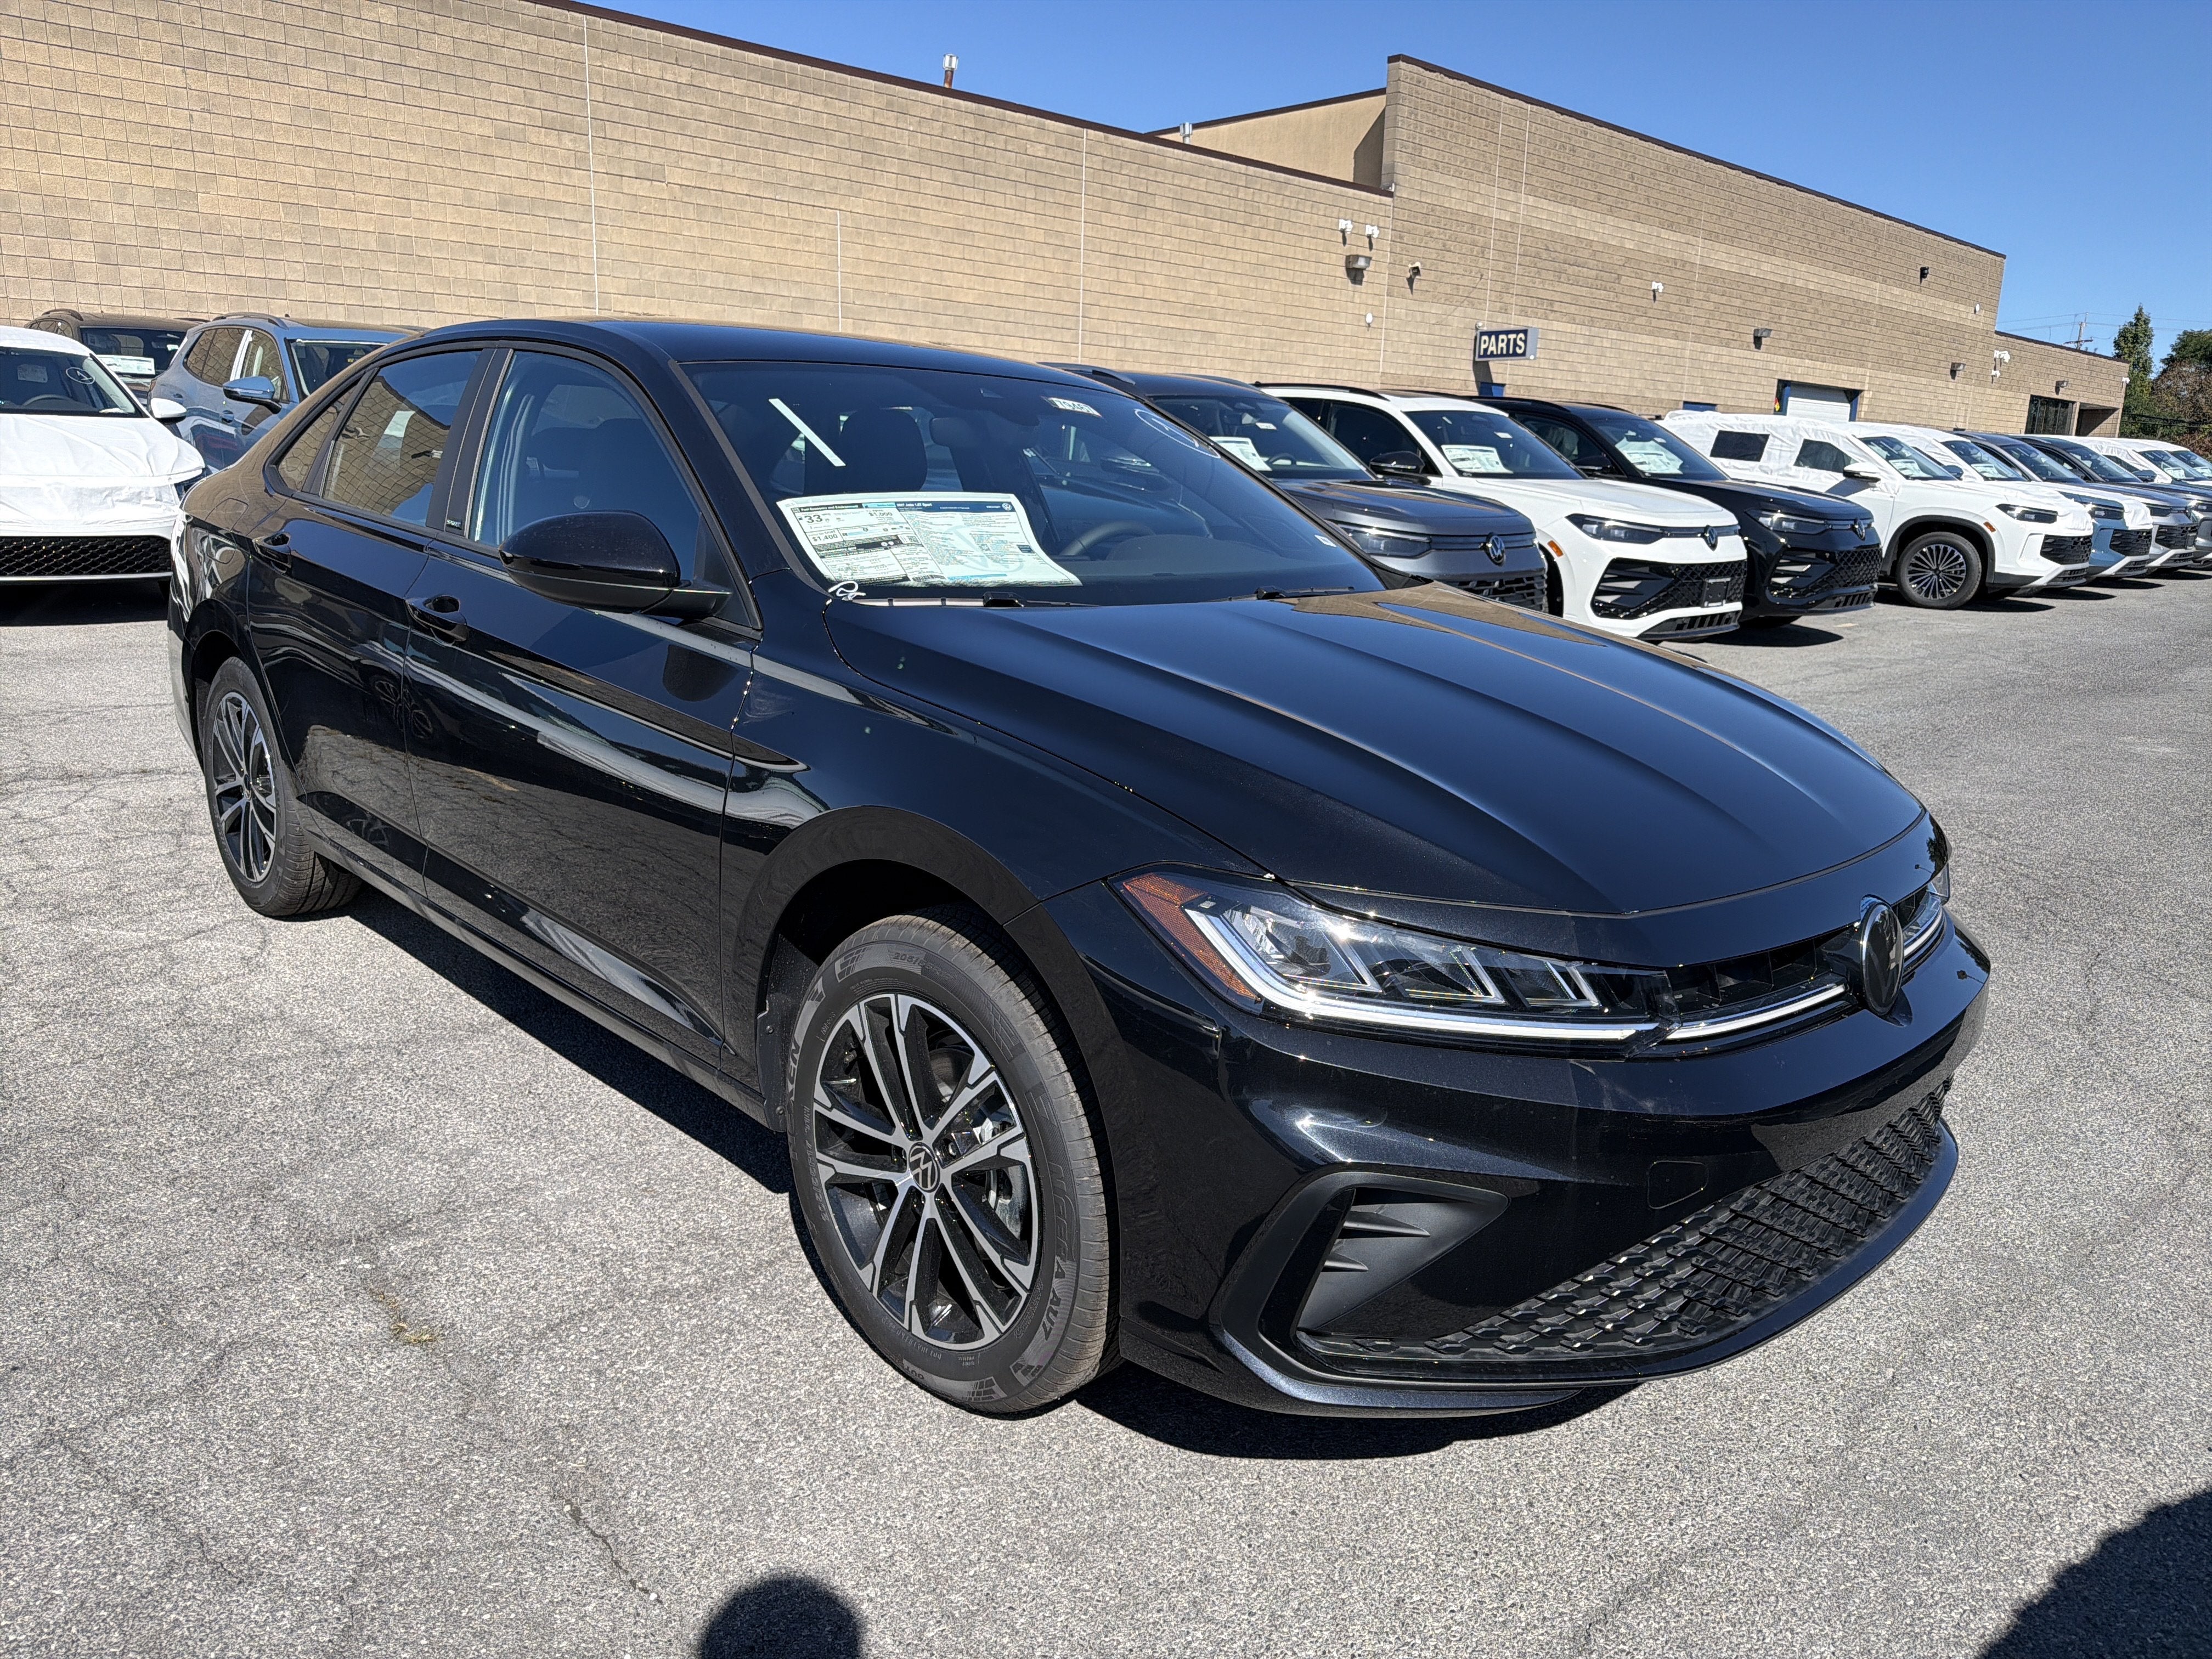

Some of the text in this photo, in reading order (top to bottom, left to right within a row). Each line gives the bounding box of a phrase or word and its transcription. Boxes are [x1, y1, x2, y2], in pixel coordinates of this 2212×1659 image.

[1480, 332, 1525, 356] PARTS
[804, 515, 823, 523] 33
[812, 534, 838, 542] $1,400
[787, 1039, 800, 1161] NEXEN
[1042, 1287, 1062, 1341] AU7
